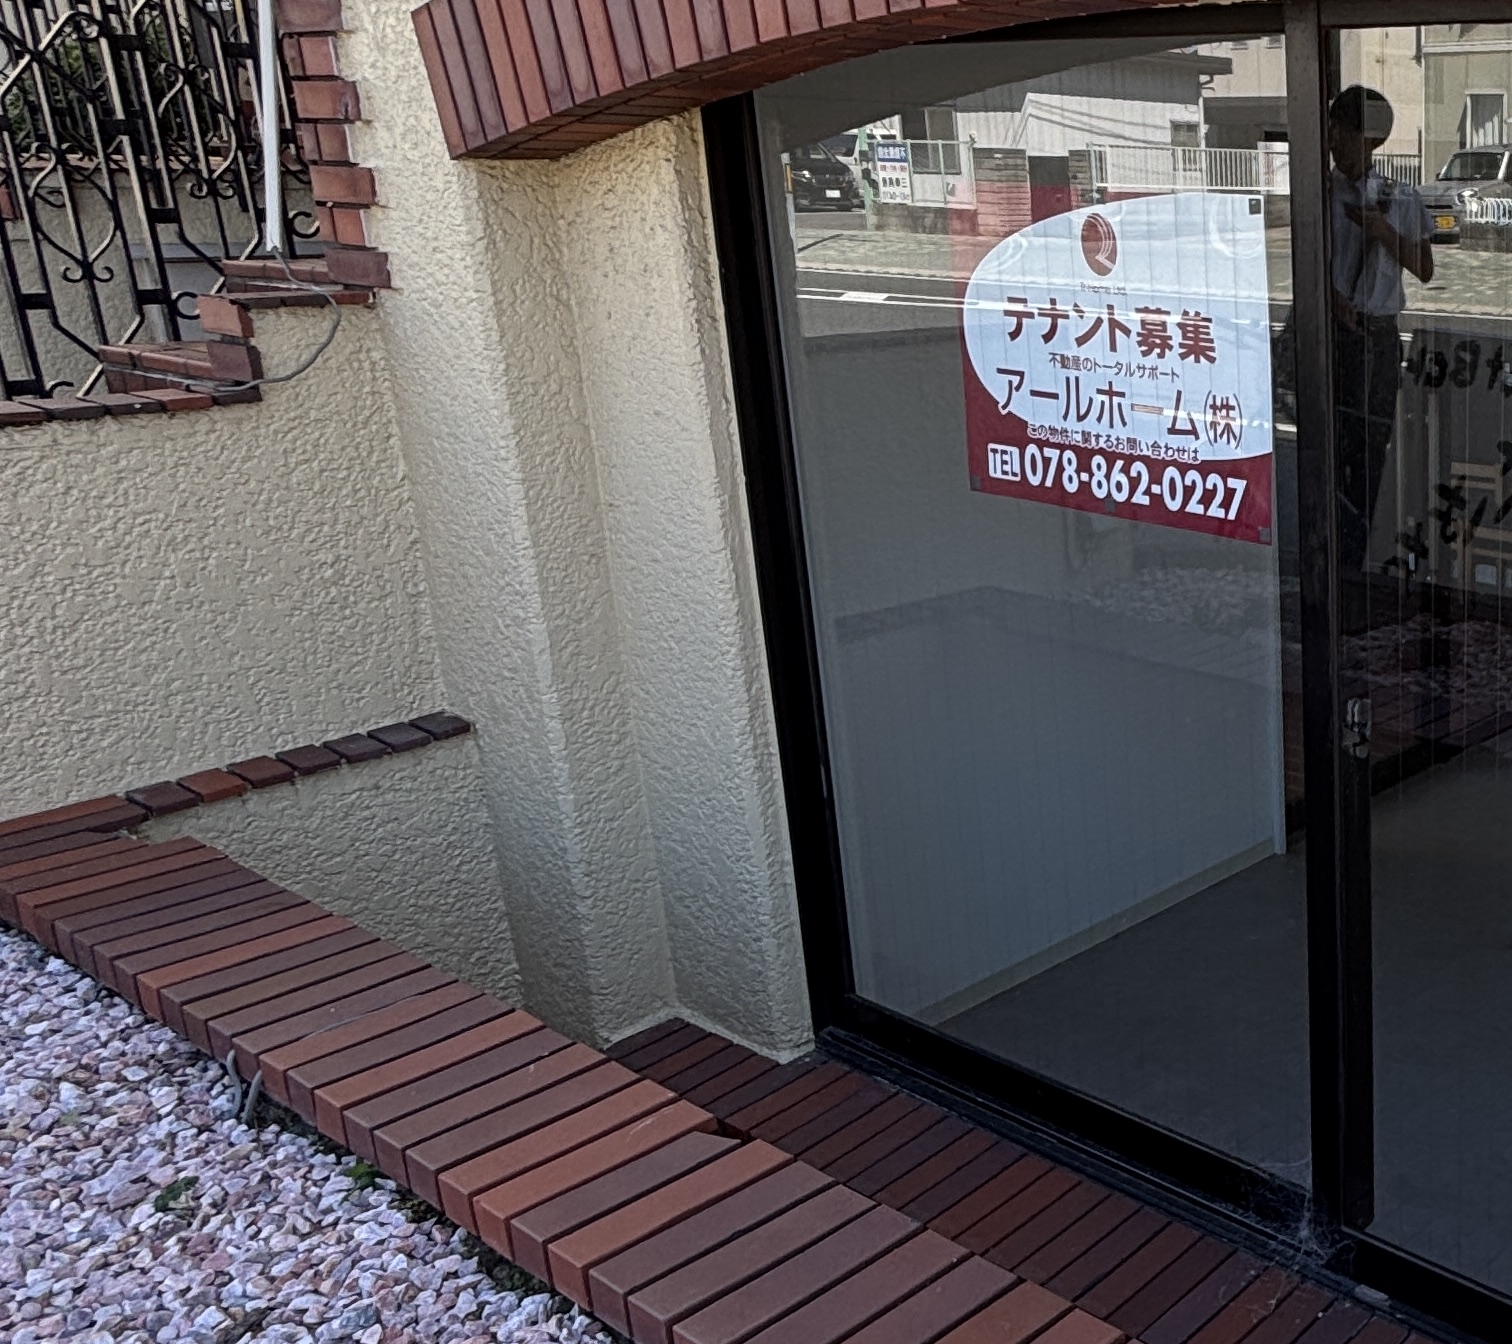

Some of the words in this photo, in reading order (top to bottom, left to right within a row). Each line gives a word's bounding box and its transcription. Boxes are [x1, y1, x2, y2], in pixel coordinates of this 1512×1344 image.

[1002, 296, 1217, 365] テナント募集
[1047, 352, 1180, 383] 不動産のトータルサポート
[1028, 423, 1200, 463] この物件に関するお問い合わせは
[989, 447, 1020, 478] TEL
[1024, 443, 1248, 521] 078-862-0227
